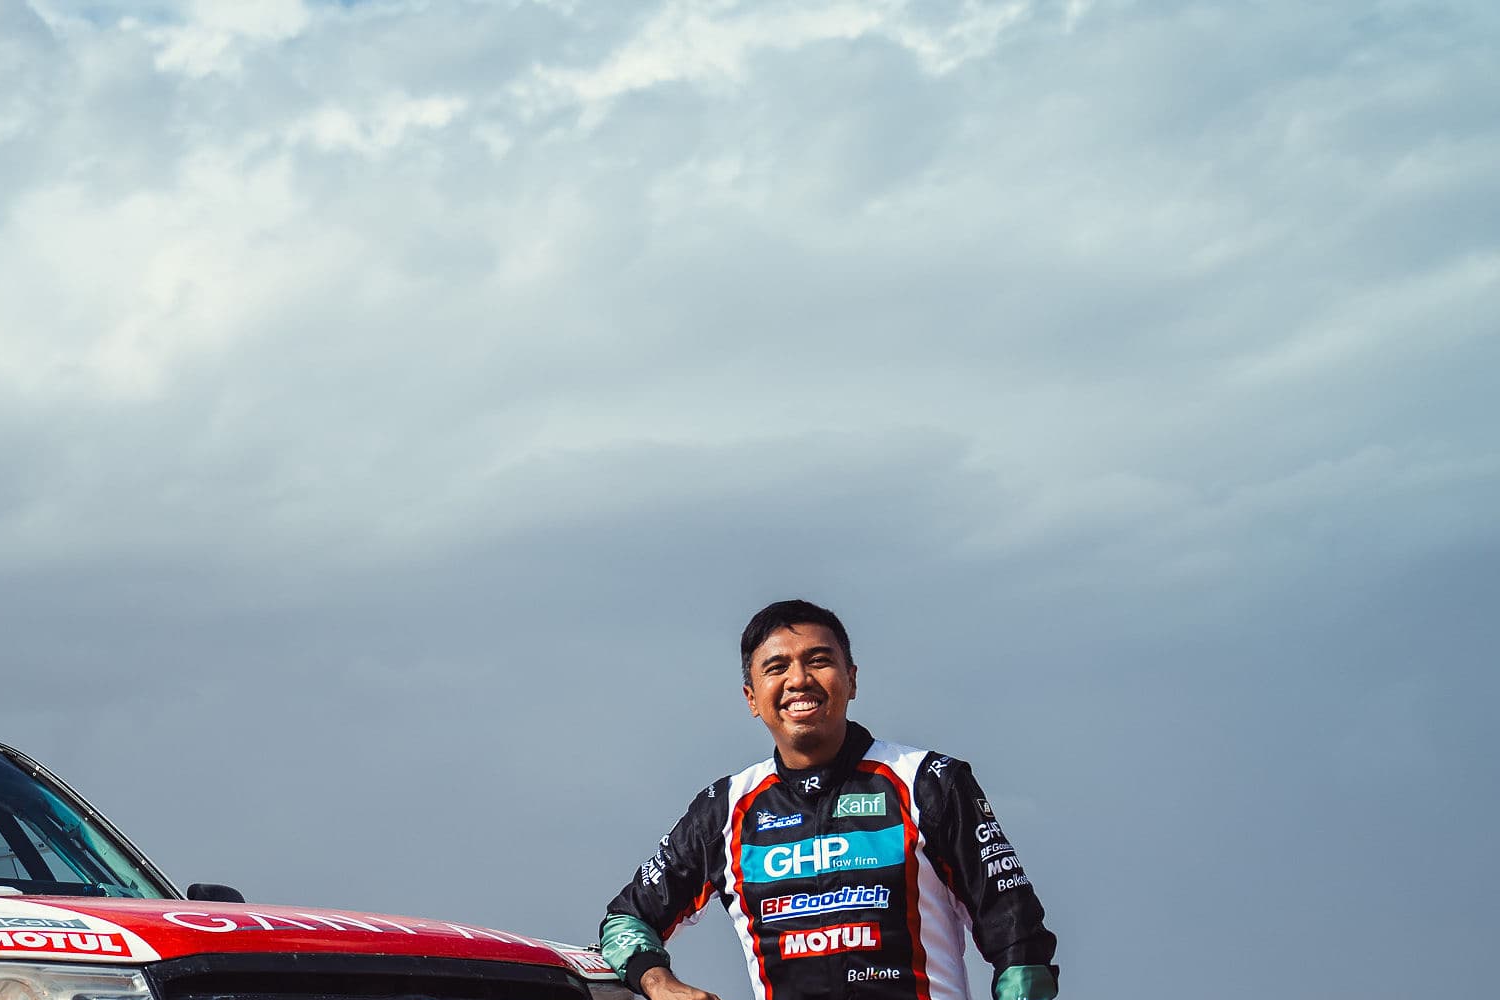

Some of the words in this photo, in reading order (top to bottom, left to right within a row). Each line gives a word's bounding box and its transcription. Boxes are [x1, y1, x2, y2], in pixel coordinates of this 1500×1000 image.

[837, 796, 881, 815] Kahf
[763, 836, 849, 878] GHP
[832, 857, 851, 868] law
[854, 856, 878, 866] firm
[762, 884, 890, 916] BFGoodrich
[784, 926, 876, 955] MOTUL
[847, 967, 900, 982] Belkote
